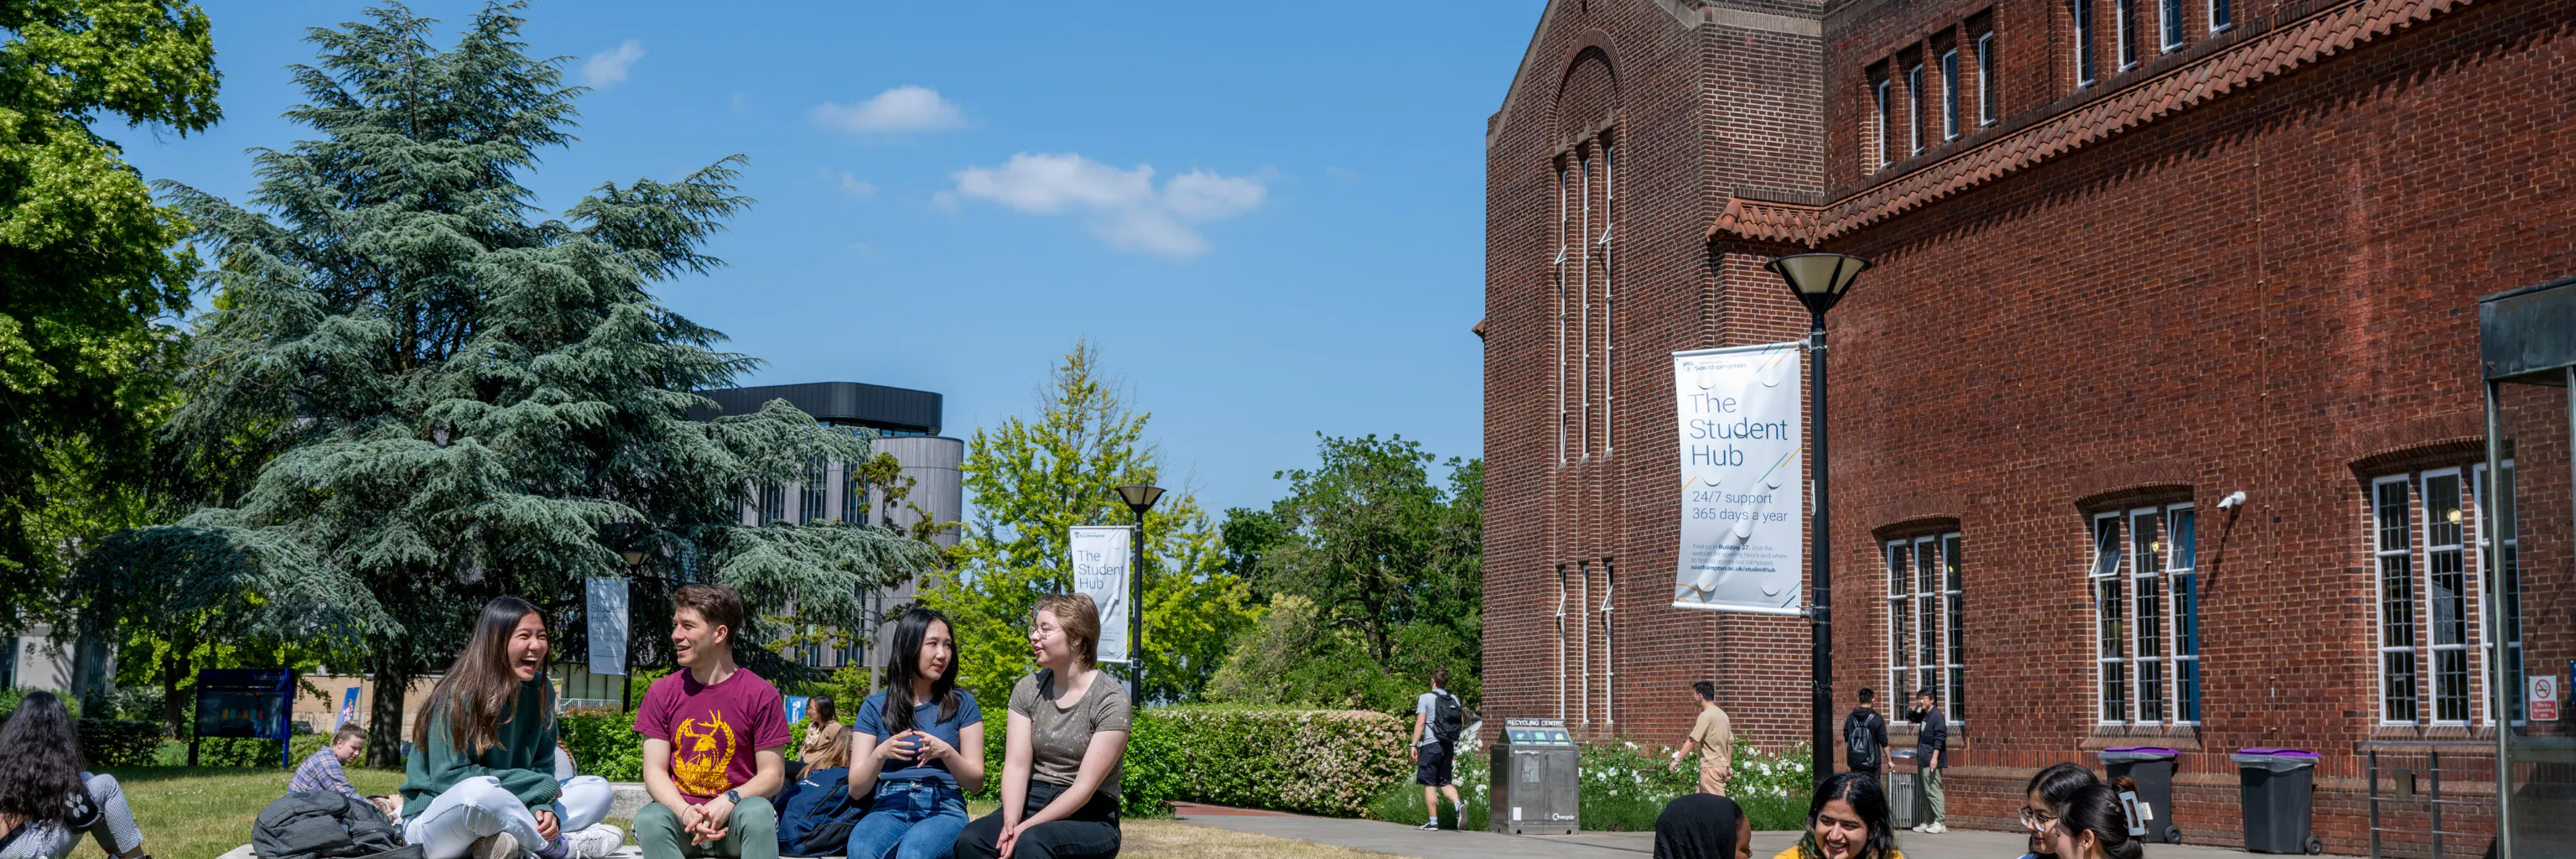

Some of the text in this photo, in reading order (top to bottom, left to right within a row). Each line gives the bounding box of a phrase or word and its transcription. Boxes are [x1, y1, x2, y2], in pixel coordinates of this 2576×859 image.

[1687, 393, 1737, 413] The
[1690, 417, 1788, 440] Student
[1692, 444, 1743, 466] Hub
[1692, 491, 1773, 505] 24/7 support
[1692, 508, 1716, 519] 365
[1720, 508, 1749, 523] days
[1763, 513, 1788, 523] year
[1077, 549, 1101, 561] The
[1078, 564, 1124, 575] Student
[1690, 565, 1776, 573] southampton.ac.uk/studenthub
[1079, 577, 1104, 589] Hub
[591, 614, 609, 622] Hub
[687, 763, 709, 773] TEAM
